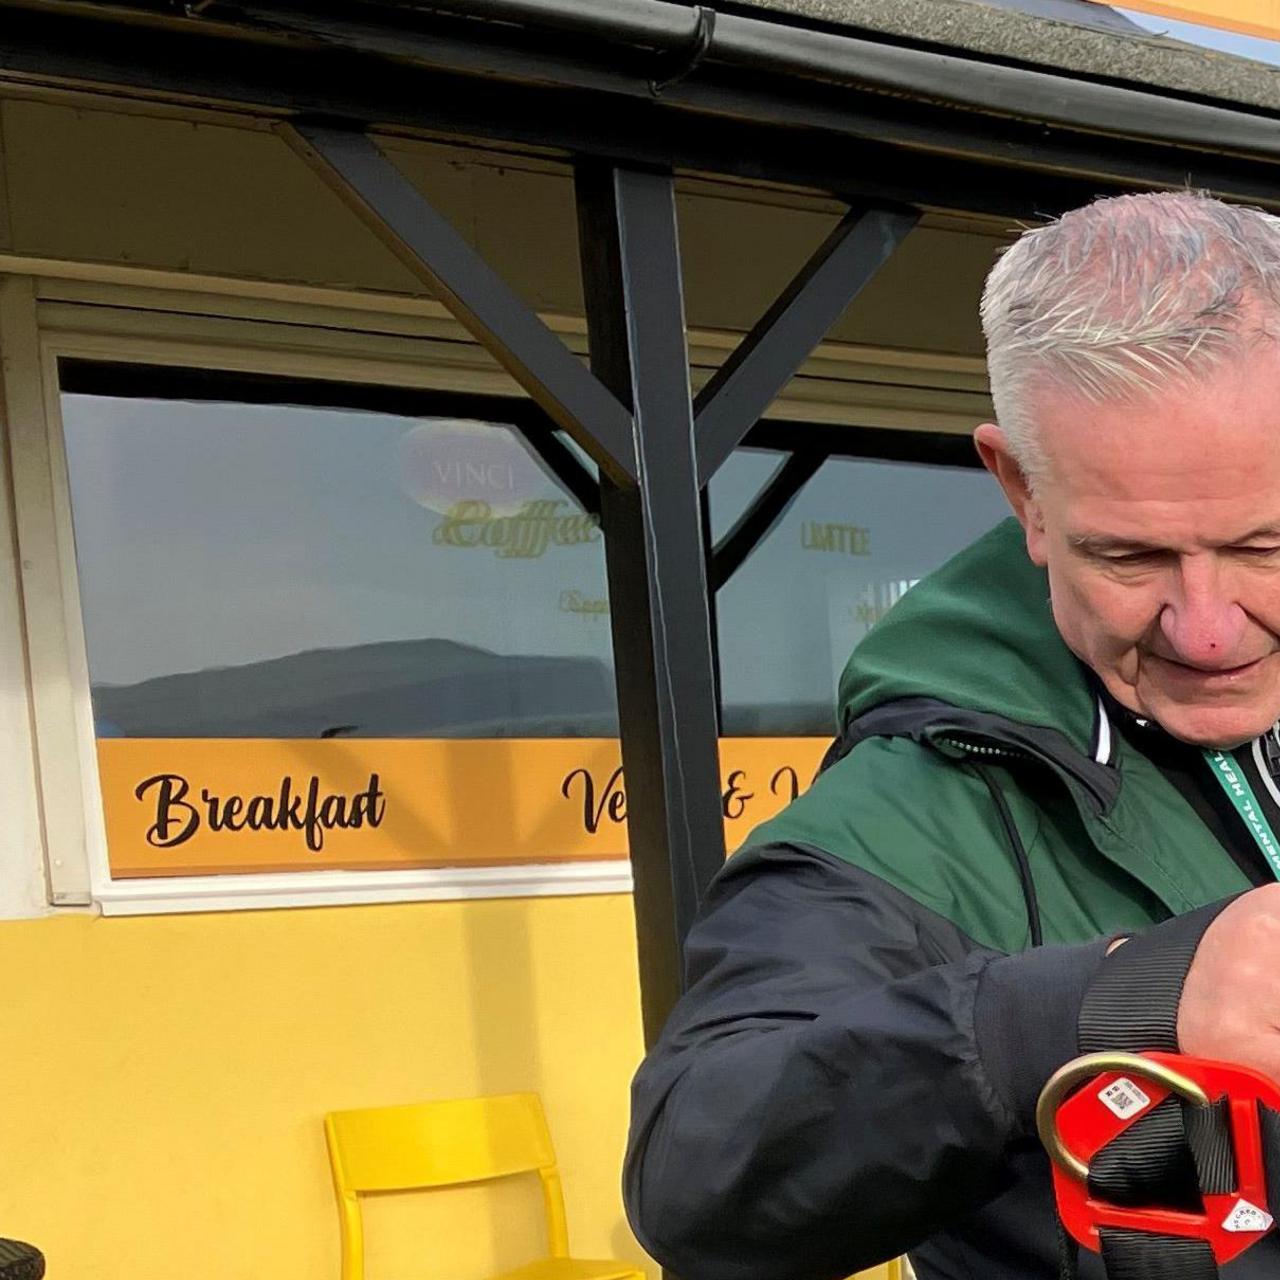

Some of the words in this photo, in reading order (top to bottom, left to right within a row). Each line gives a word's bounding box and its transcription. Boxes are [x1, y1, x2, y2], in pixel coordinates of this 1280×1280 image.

[561, 766, 629, 834] Ve
[1213, 752, 1245, 797] HEAL
[135, 773, 386, 852] Breakfast
